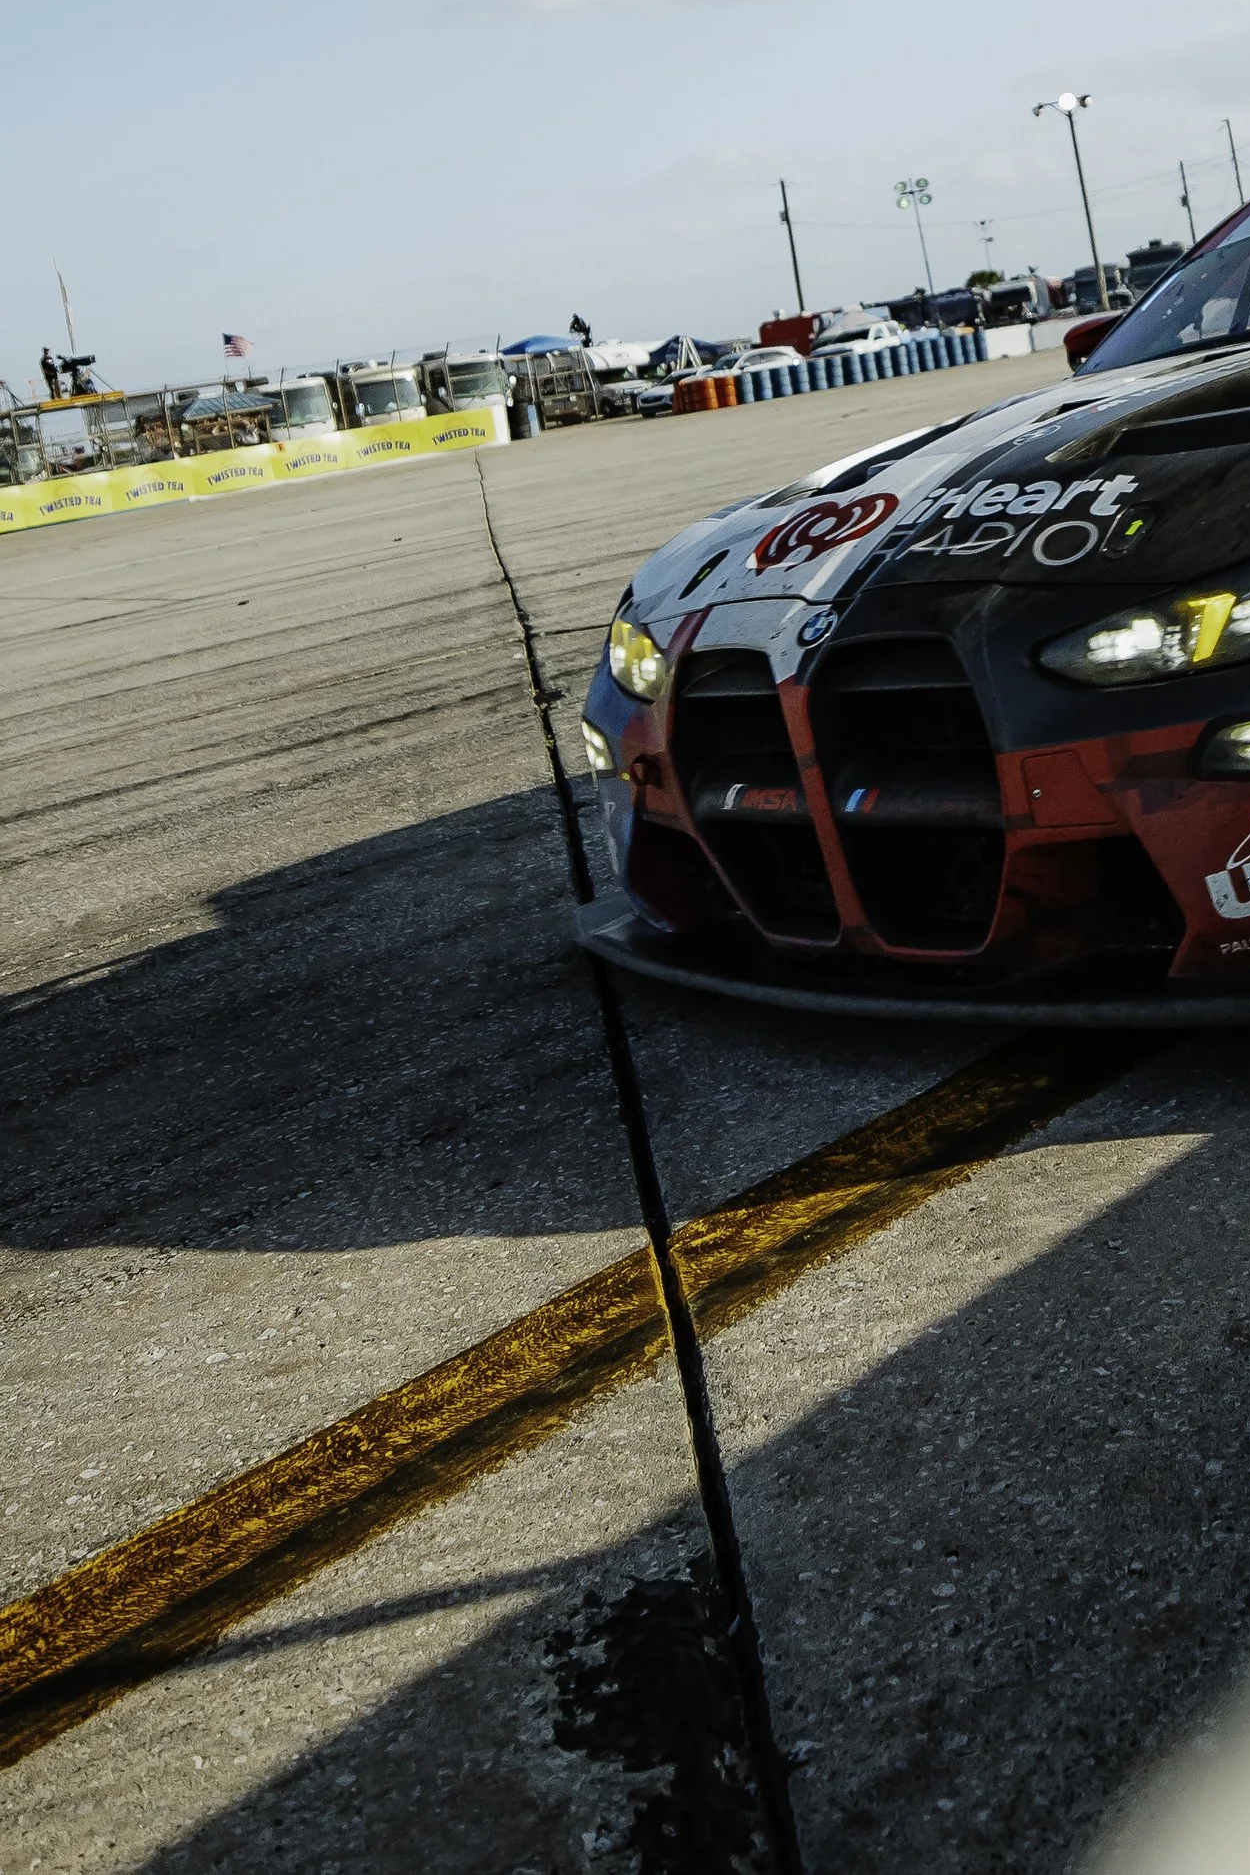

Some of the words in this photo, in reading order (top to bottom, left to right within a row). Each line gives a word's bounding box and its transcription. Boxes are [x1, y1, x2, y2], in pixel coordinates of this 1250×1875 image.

[431, 428, 469, 445] TWISTED
[470, 427, 486, 438] TEA
[356, 440, 393, 459] TWISTED
[395, 440, 411, 450] TEA
[285, 453, 321, 472] TWISTED
[323, 453, 338, 463] TEA
[206, 467, 246, 486] TWISTED
[248, 467, 264, 477] TEA
[125, 481, 165, 501] TWISTED
[167, 481, 184, 491] TEA
[897, 474, 1140, 525] iHeart
[37, 496, 82, 516] TWISTED
[84, 496, 102, 506] TEA
[860, 519, 1100, 570] RADIO
